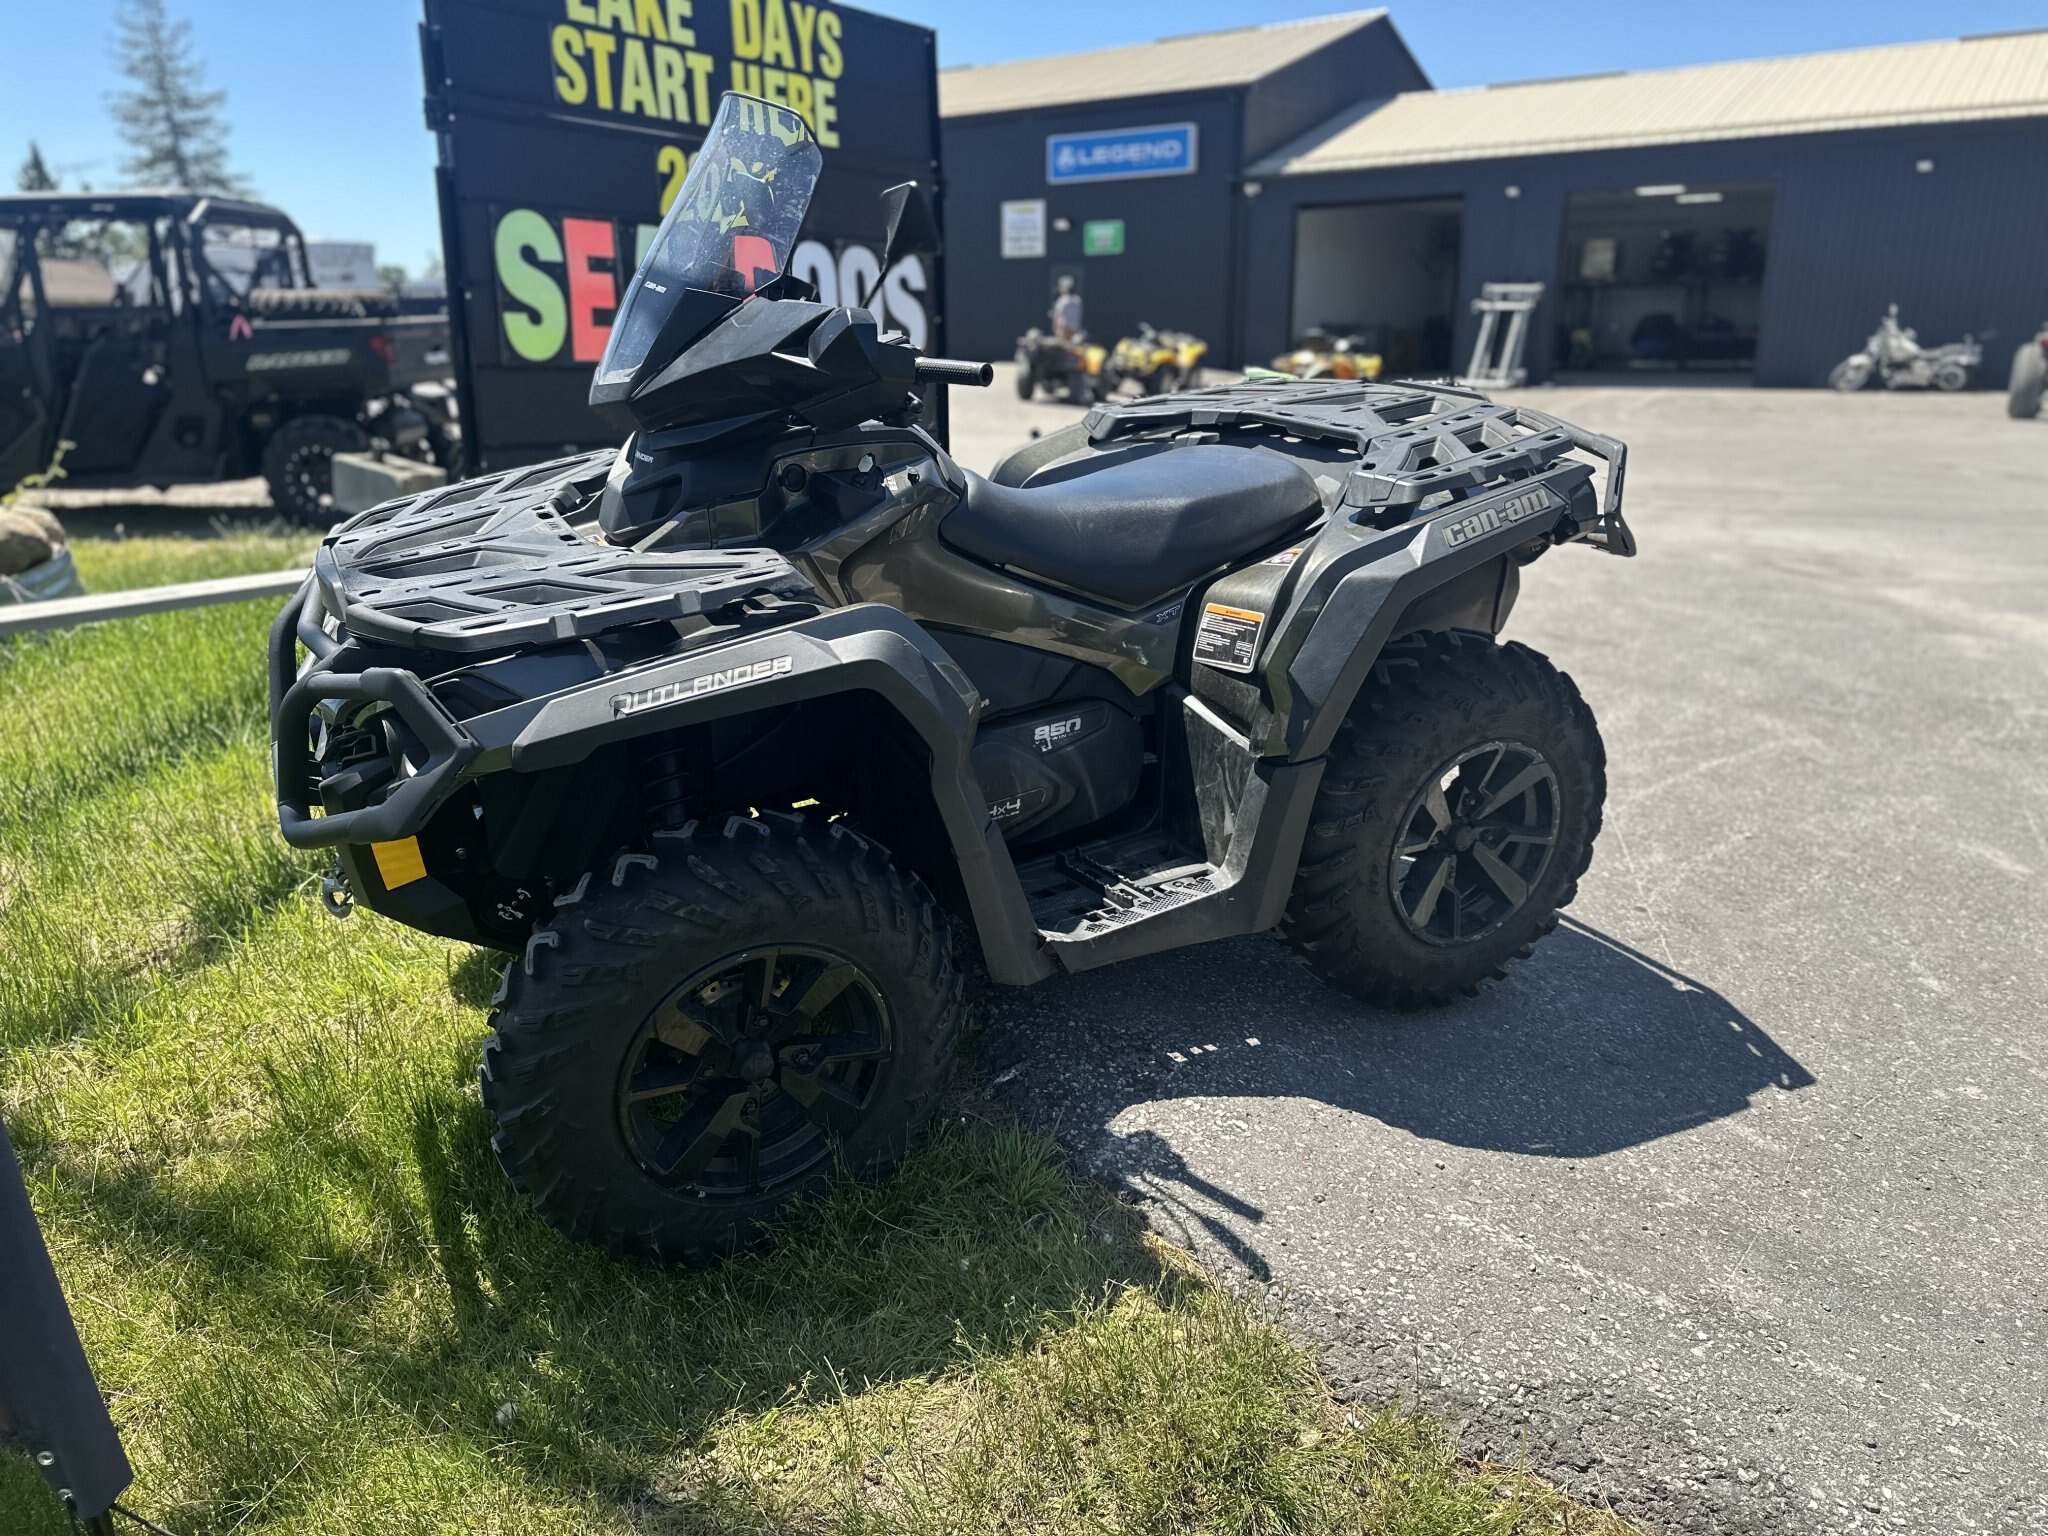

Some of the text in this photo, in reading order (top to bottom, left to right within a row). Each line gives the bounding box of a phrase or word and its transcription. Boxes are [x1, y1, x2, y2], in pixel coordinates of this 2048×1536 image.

[730, 0, 844, 79] DAYS
[552, 24, 840, 148] START HERE
[1077, 138, 1183, 166] LEGEND
[1441, 488, 1550, 547] can-am
[1156, 604, 1181, 624] XT
[1034, 717, 1082, 741] 850
